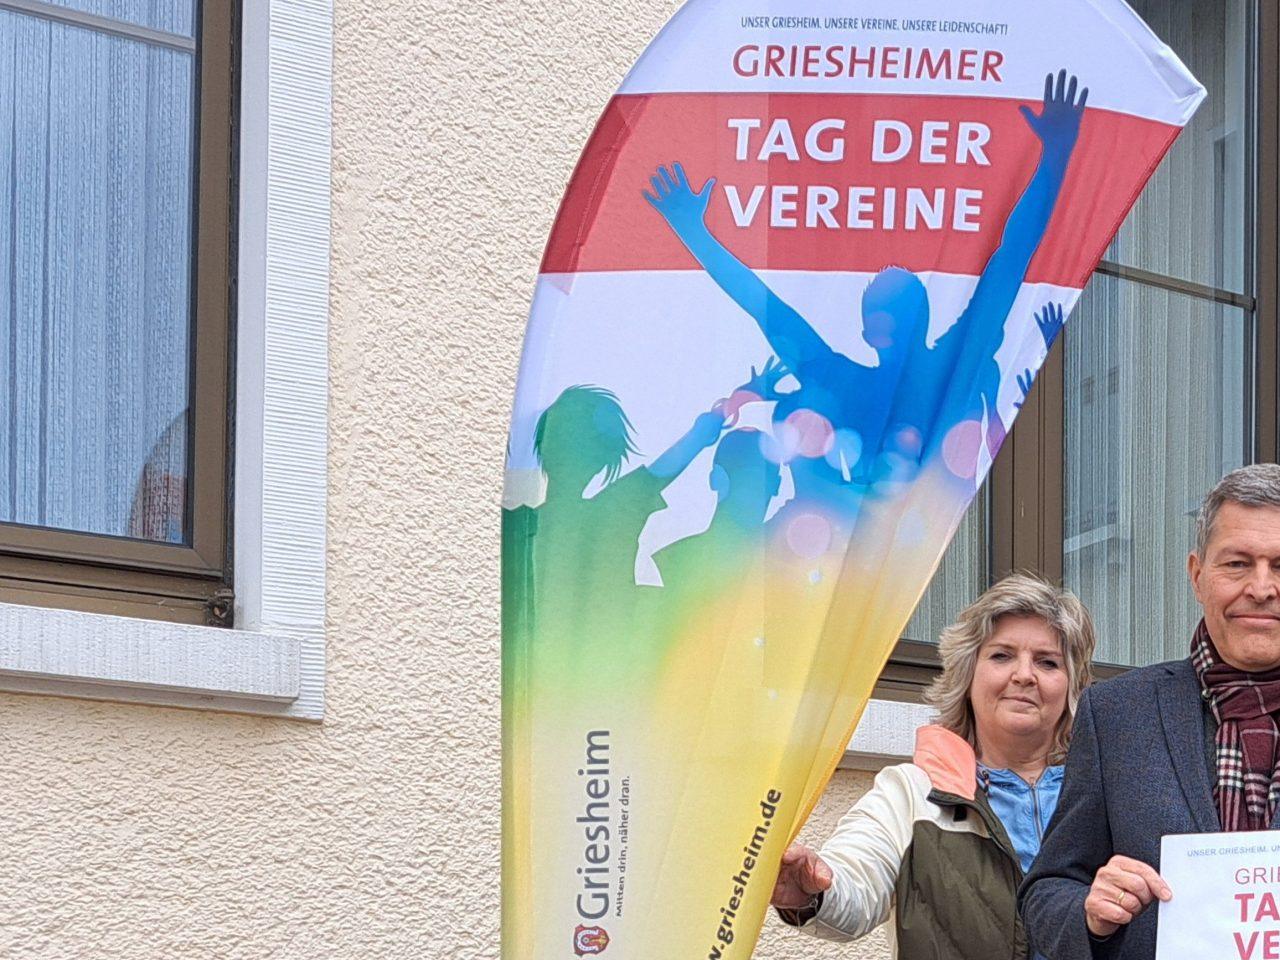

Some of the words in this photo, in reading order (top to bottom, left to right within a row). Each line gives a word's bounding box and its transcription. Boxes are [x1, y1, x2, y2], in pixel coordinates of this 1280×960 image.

[741, 16, 769, 28] UNSER
[772, 16, 821, 28] GRIESHEIM.
[824, 17, 858, 29] UNSERE
[861, 18, 899, 30] VEREINE.
[902, 19, 937, 32] UNSERE
[940, 21, 1008, 35] LEIDENSCHAFT!
[733, 44, 1003, 82] GRIESHEIMER
[727, 118, 845, 162] TAG
[871, 119, 991, 166] DER
[723, 185, 983, 232] VEREINE
[621, 776, 630, 807] dran.
[576, 730, 610, 920] Griesheim
[620, 809, 629, 844] näher
[619, 845, 628, 873] drin,
[1187, 848, 1216, 857] UNSER
[616, 876, 625, 917] Mitten
